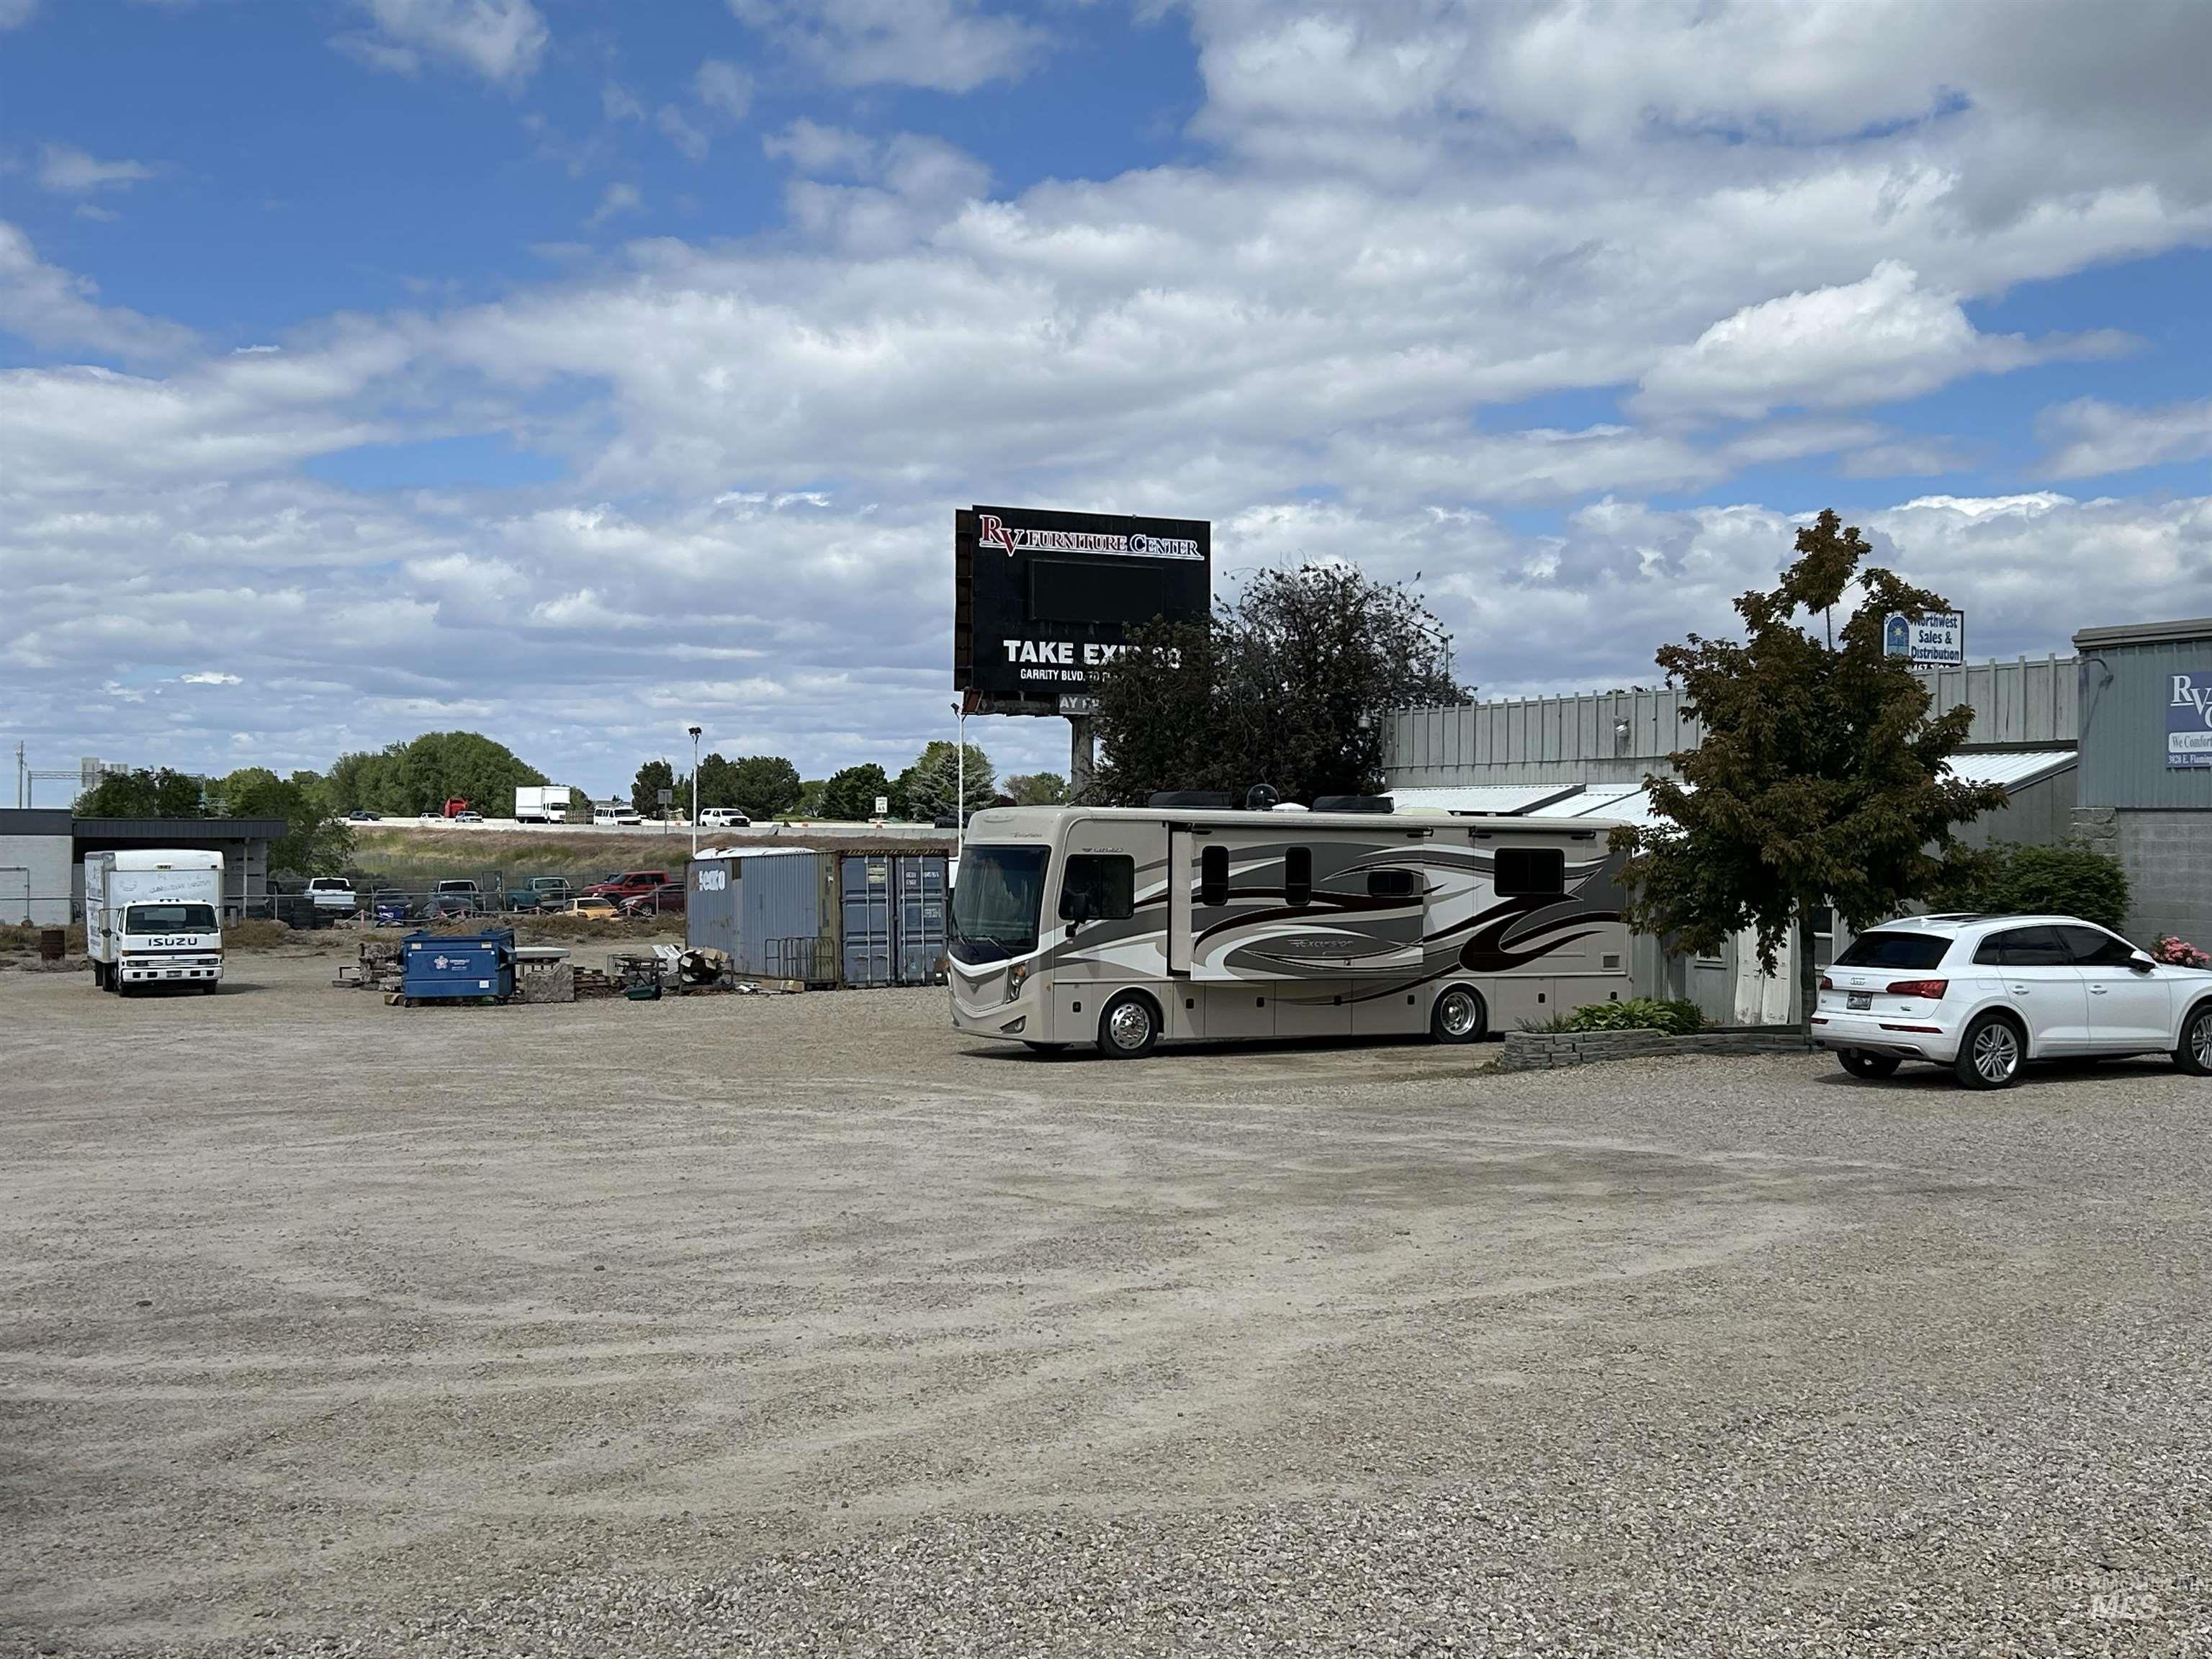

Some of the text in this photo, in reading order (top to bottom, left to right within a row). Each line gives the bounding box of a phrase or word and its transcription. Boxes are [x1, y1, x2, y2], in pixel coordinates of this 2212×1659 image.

[979, 515, 1202, 557] RV FURNITURE CENTER
[1918, 629, 1953, 644] Sales &
[1003, 639, 1074, 664] TAKE
[1084, 643, 1141, 665] EXI
[1912, 645, 1959, 660] Distribution
[1020, 668, 1058, 680] GARRITY
[1061, 670, 1086, 681] BLVD.
[2172, 675, 2212, 715] RV
[148, 938, 197, 946] ISUZU
